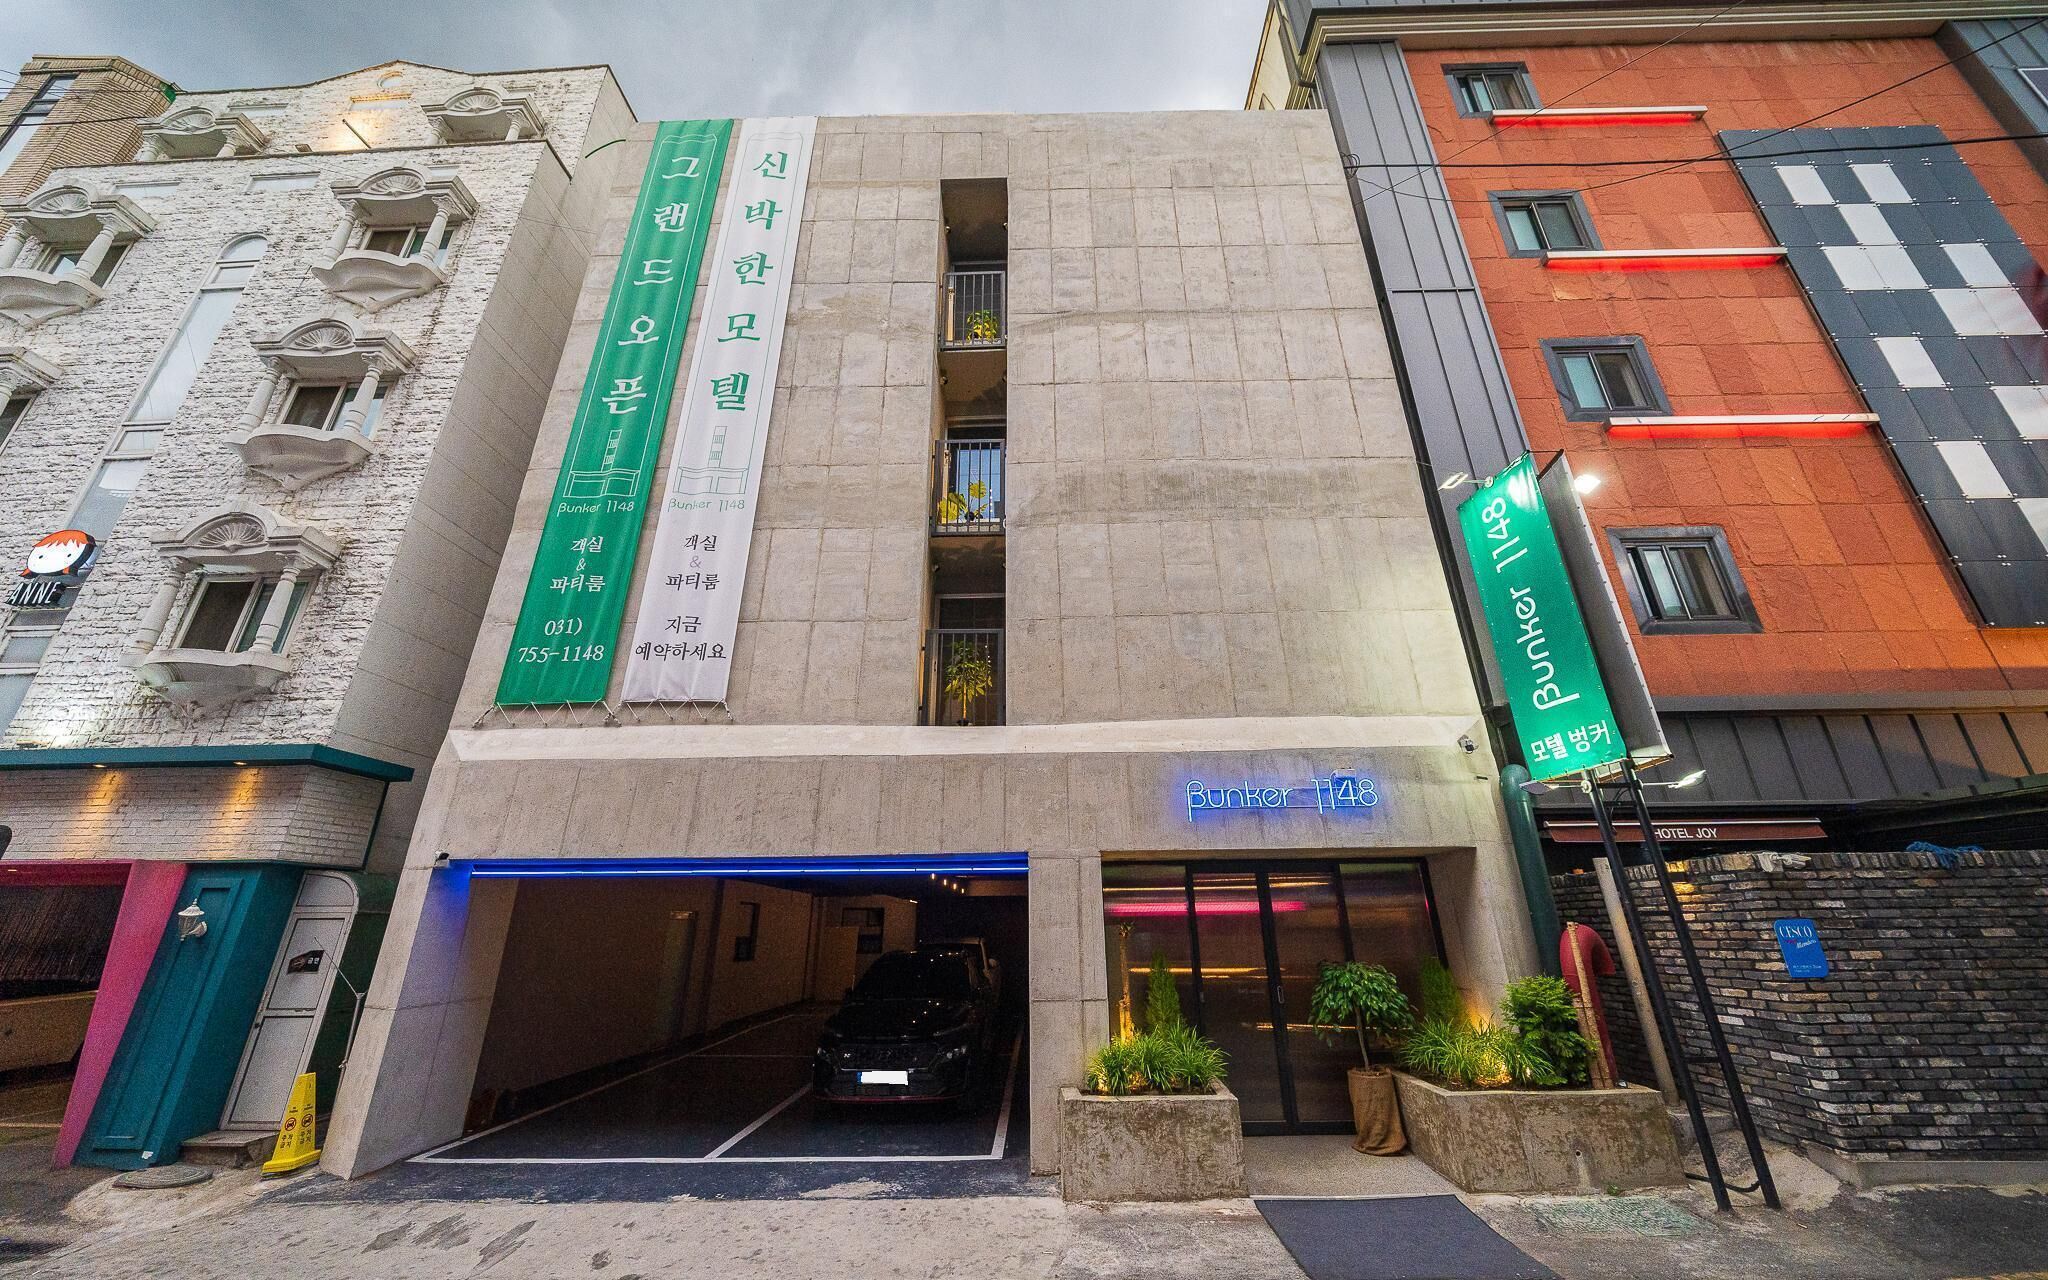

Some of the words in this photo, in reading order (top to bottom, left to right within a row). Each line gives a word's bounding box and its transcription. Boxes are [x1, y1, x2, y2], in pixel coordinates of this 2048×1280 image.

[606, 499, 635, 514] 1148
[719, 498, 745, 512] 1148
[684, 535, 717, 552] 객실
[1481, 496, 1529, 574] 1148
[571, 536, 604, 553] 객실
[577, 558, 586, 571] &
[690, 556, 702, 568] &
[550, 575, 606, 593] 파티룸
[665, 574, 720, 592] 파티룸
[8, 581, 61, 604] ANNE
[544, 618, 583, 636] 031)
[664, 616, 702, 634] 지금
[518, 645, 605, 663] 755-1148
[635, 642, 727, 661] 예약하세요
[1531, 733, 1568, 763] 모텔
[1569, 720, 1611, 754] 벙커
[1311, 778, 1379, 815] 1148
[1655, 828, 1693, 839] HOTEL
[1696, 828, 1717, 839] JOY
[1779, 925, 1812, 938] CESCO
